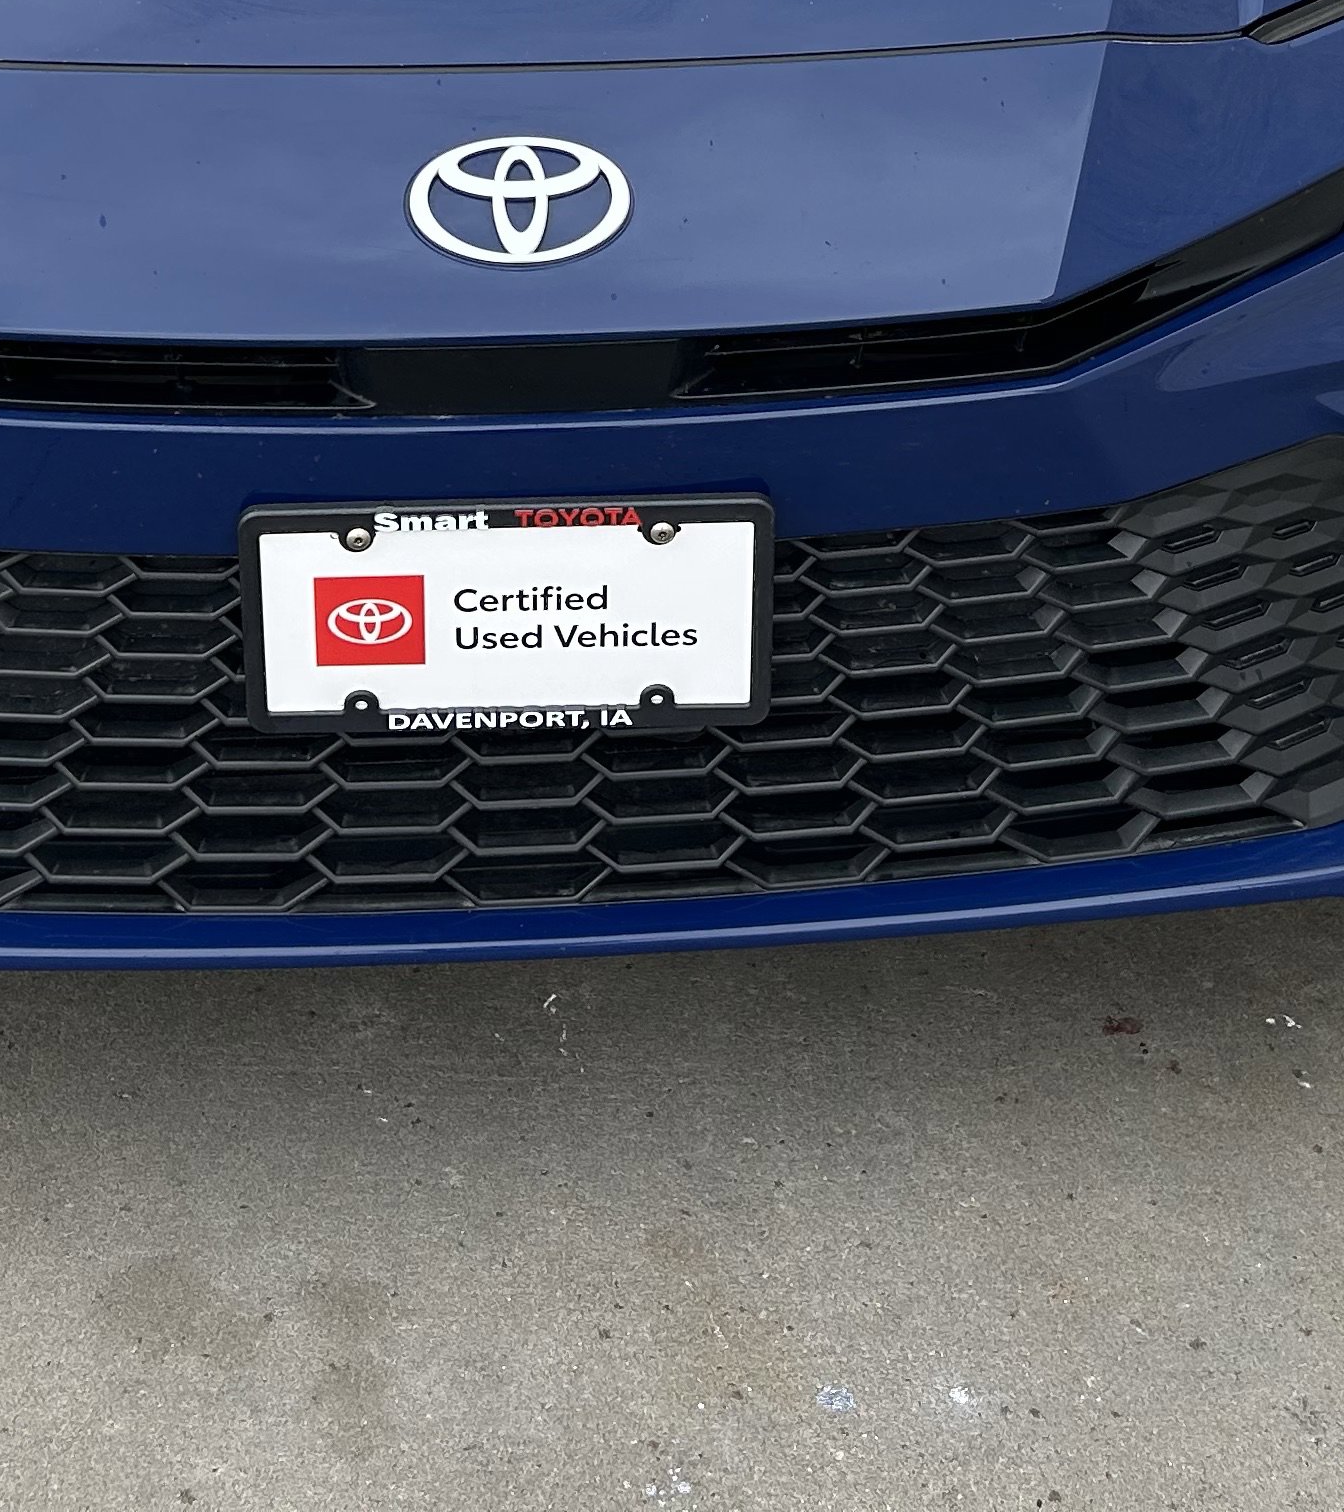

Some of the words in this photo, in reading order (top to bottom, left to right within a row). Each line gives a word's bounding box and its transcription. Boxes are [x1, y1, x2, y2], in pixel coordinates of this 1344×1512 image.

[373, 508, 489, 532] Smart
[514, 506, 642, 528] TOYOTA
[454, 584, 608, 613] Certified
[455, 624, 543, 650] Used
[554, 621, 699, 648] Vehicles
[387, 709, 590, 731] DAVENPORT,
[601, 708, 634, 727] IA
